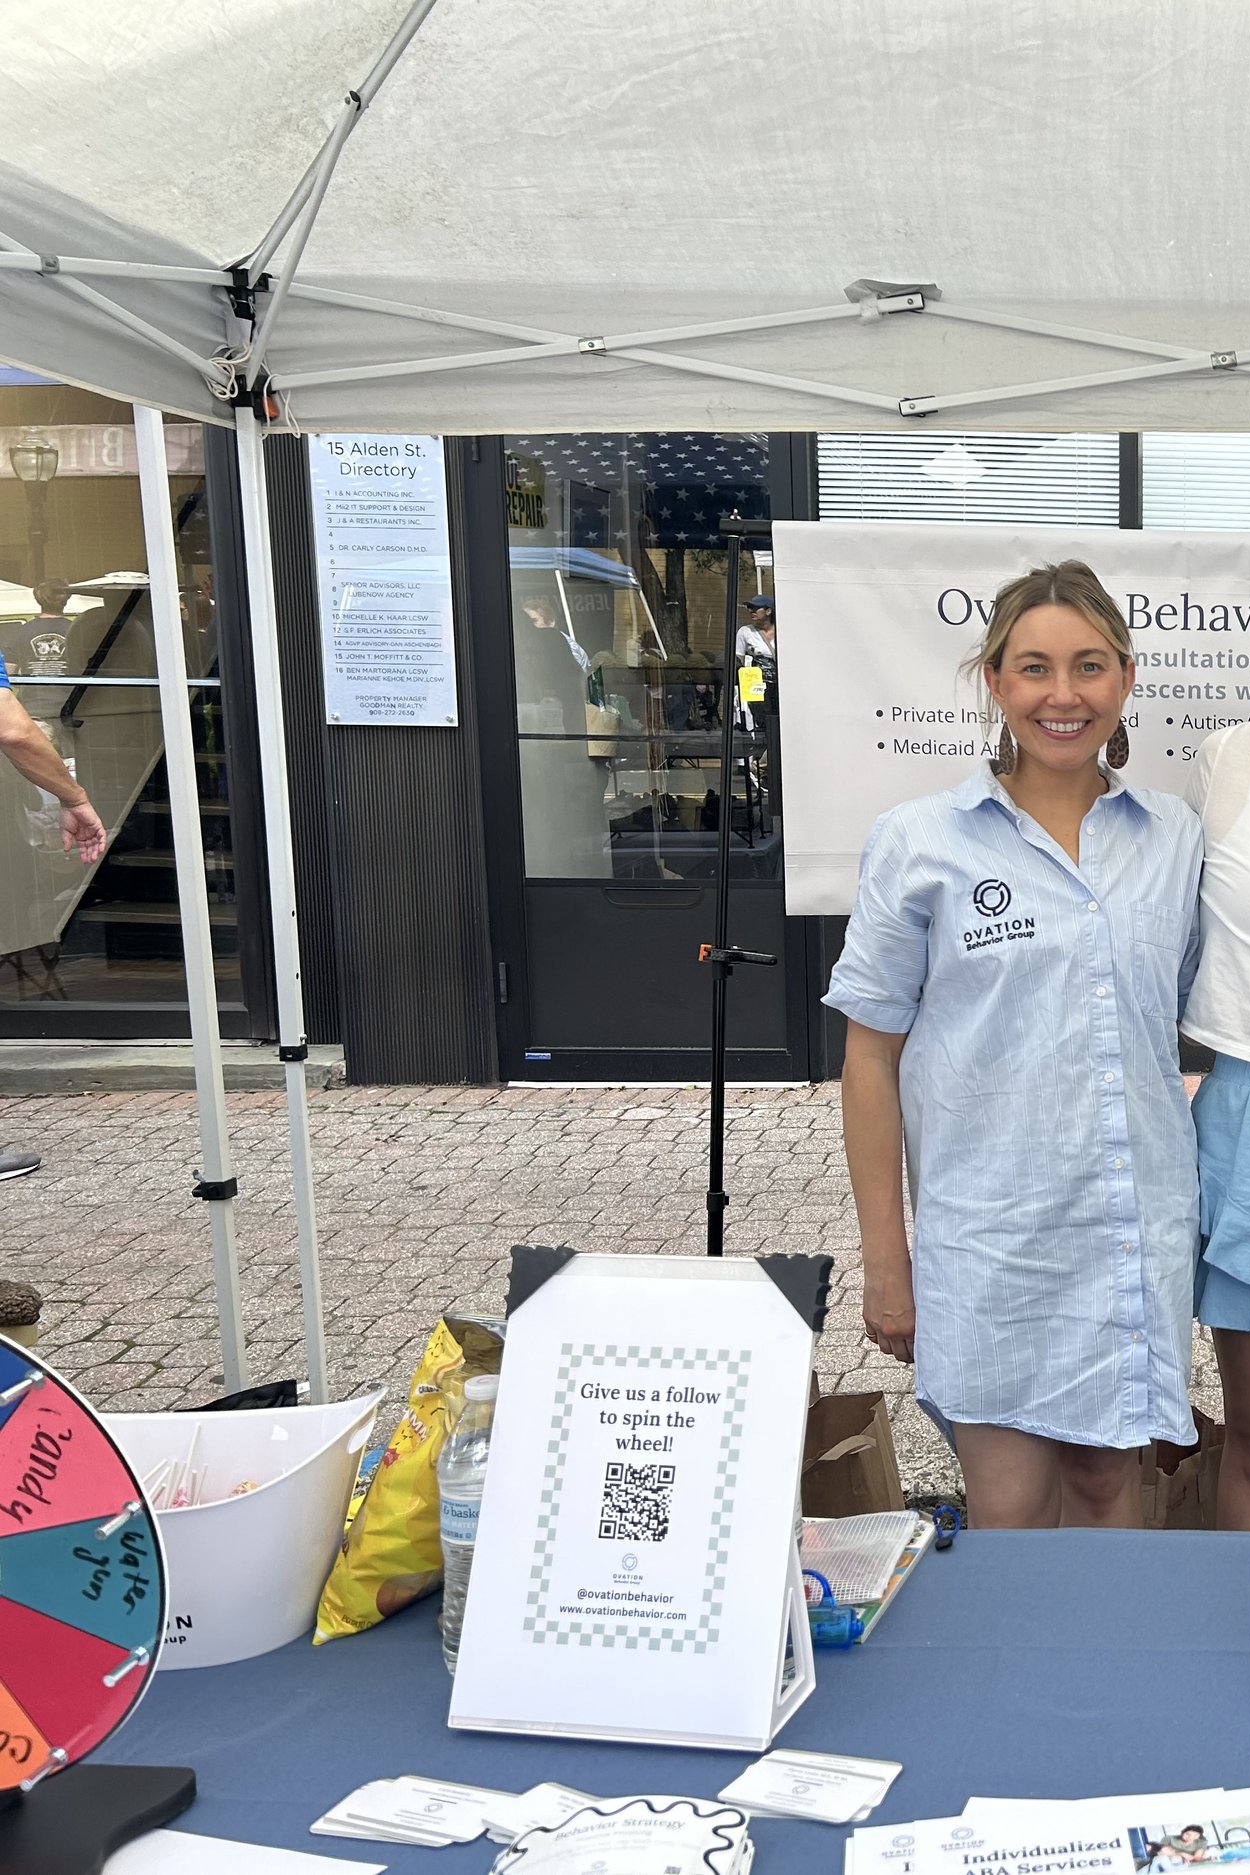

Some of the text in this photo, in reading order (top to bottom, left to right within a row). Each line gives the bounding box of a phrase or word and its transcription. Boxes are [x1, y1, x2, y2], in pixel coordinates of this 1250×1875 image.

[327, 441, 426, 458] 15 Alden St.
[340, 462, 417, 480] Directory
[358, 504, 392, 512] SUPPORT
[356, 517, 407, 525] RESTAURANTS
[338, 544, 350, 552] DR.
[375, 545, 406, 553] CARSON
[385, 591, 415, 599] AGENCY
[342, 613, 377, 621] MICHELLE
[1131, 681, 1227, 700] escents
[891, 705, 955, 724] Private
[893, 738, 975, 757] Medicaid
[963, 917, 1036, 943] OVATION
[966, 930, 1035, 952] Behavior Group
[580, 1383, 721, 1404] Give us a follow
[600, 1409, 696, 1431] to spin the
[616, 1434, 673, 1452] wheel!
[612, 1573, 644, 1581] OVATION
[577, 1588, 675, 1604] @ovationbehavior
[559, 1605, 687, 1621] www.ovationbehavior.com
[963, 1837, 1122, 1865] Individualized
[1016, 1856, 1113, 1875] Services
